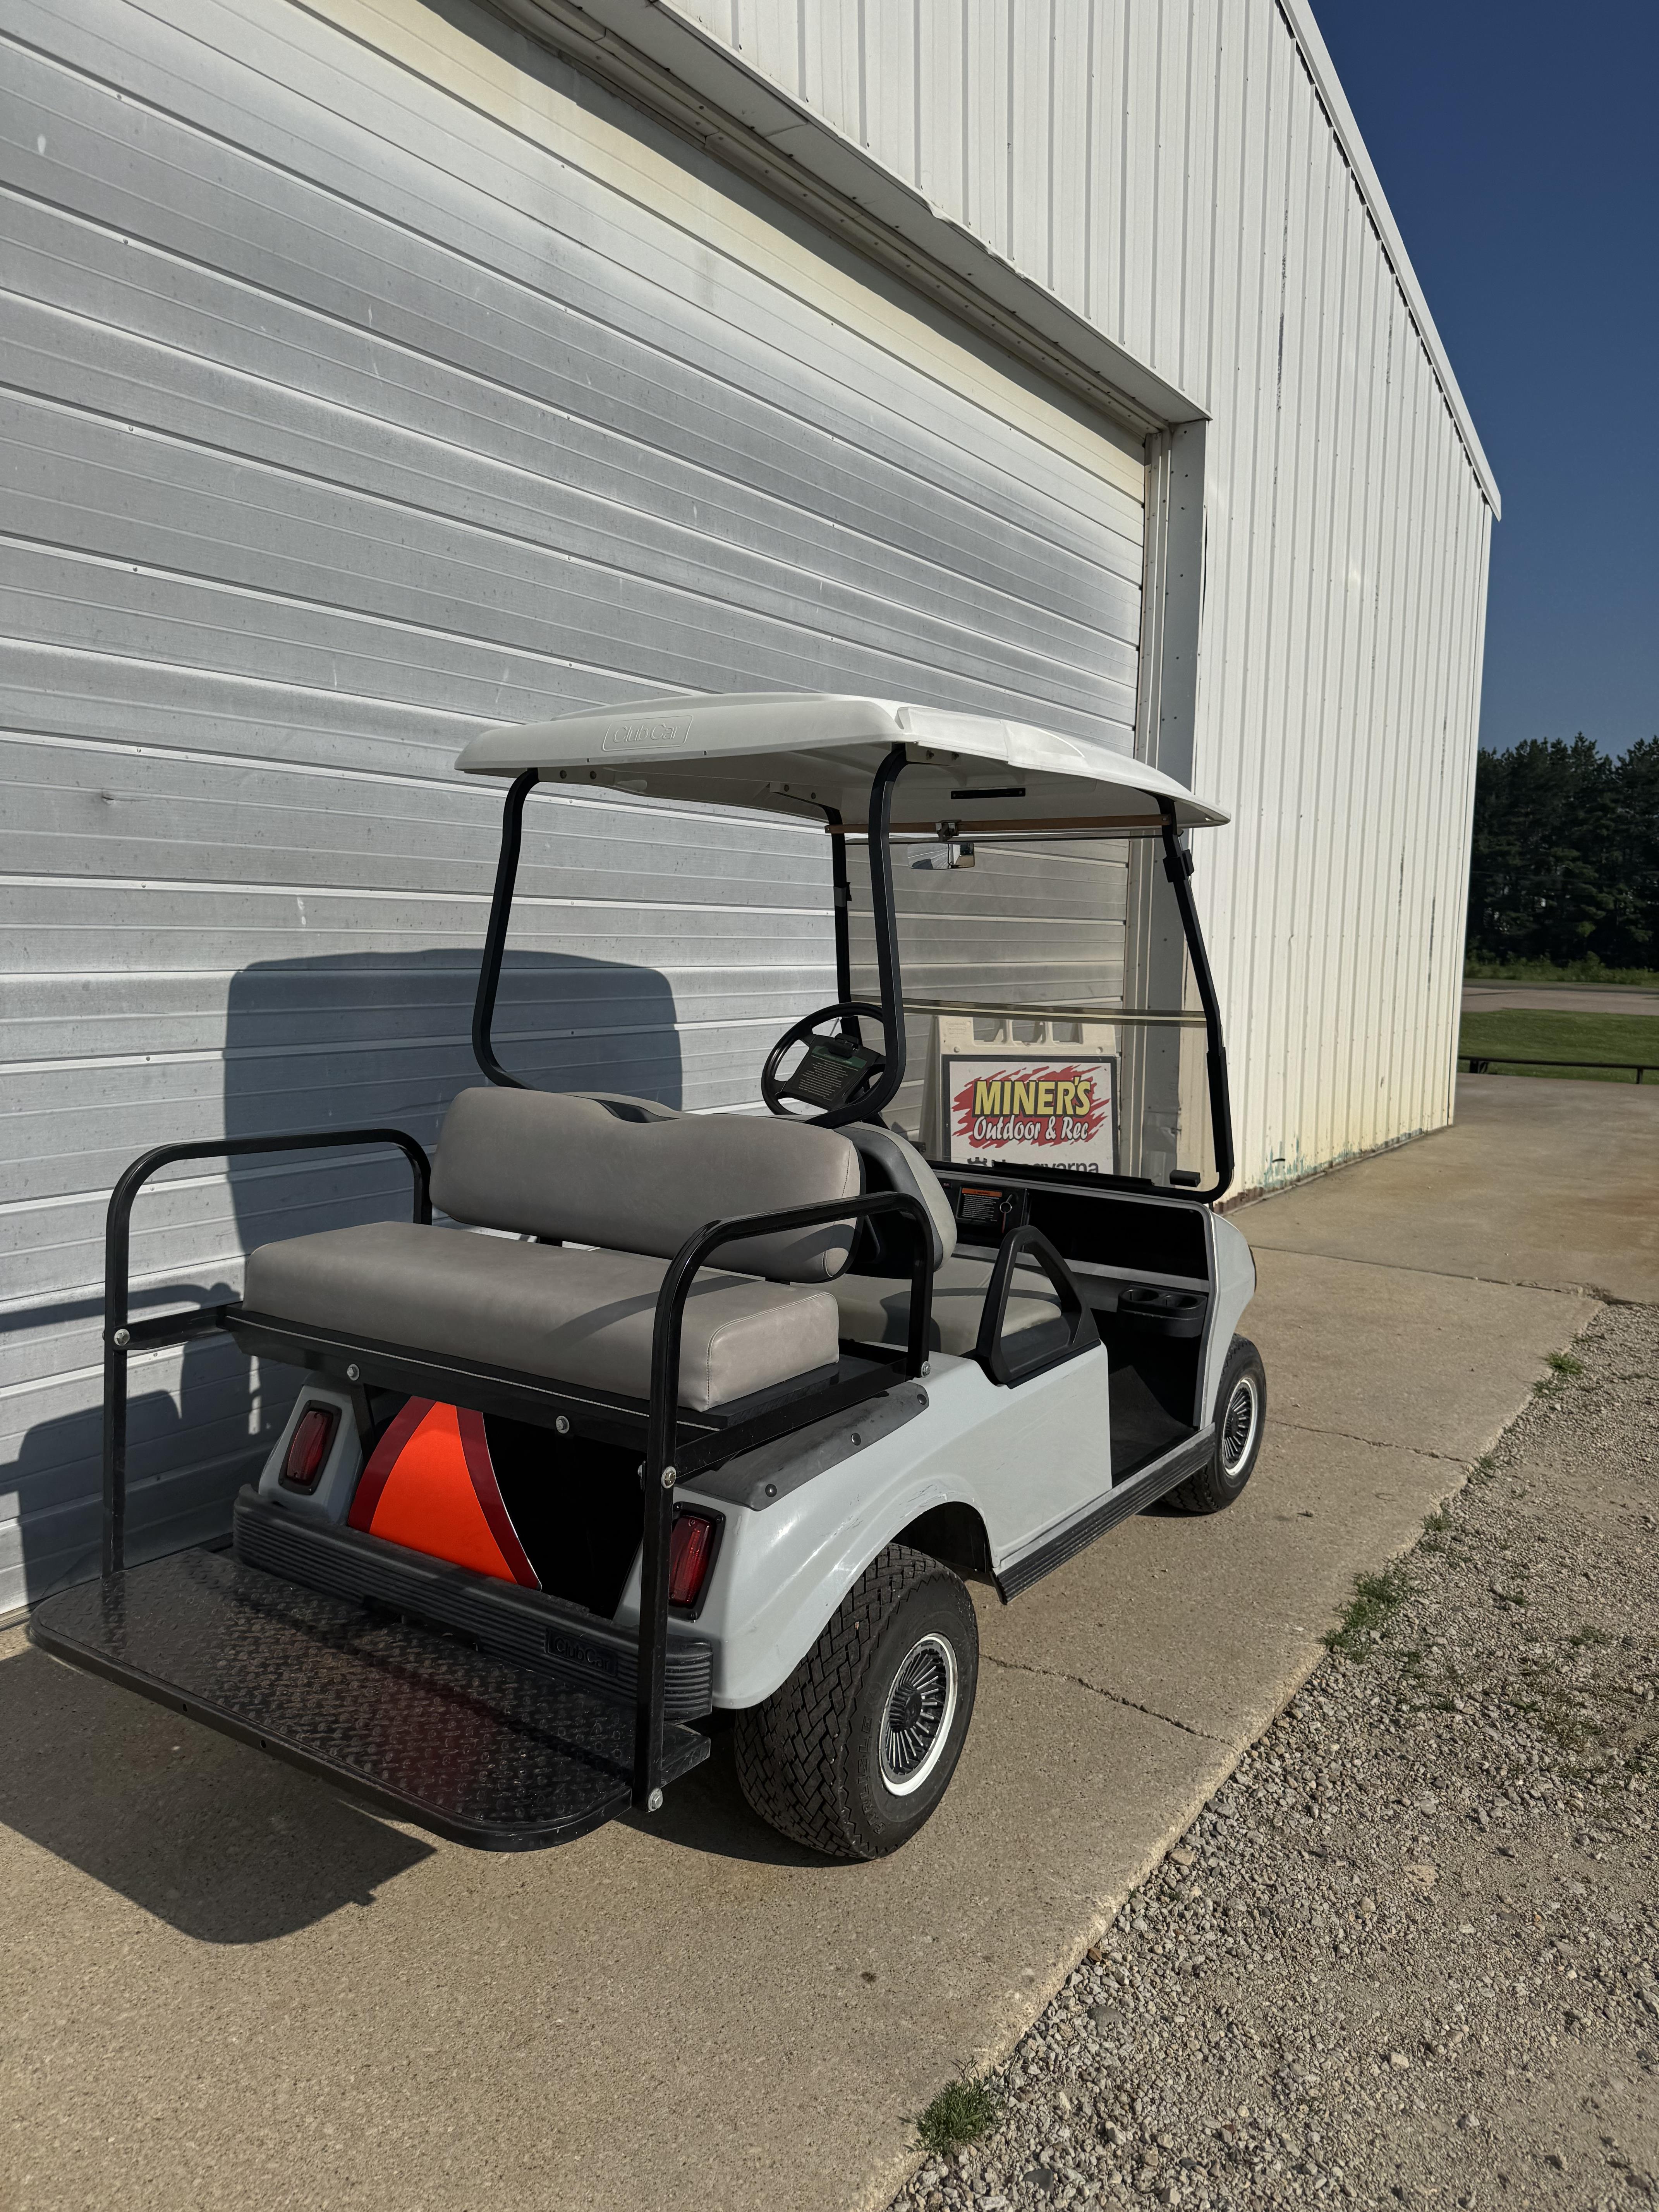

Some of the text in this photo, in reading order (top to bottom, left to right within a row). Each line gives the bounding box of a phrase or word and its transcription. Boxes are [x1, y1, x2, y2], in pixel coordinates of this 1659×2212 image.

[973, 1076, 1091, 1117] MINER'S
[973, 1115, 1089, 1140] Outdoor & Rec
